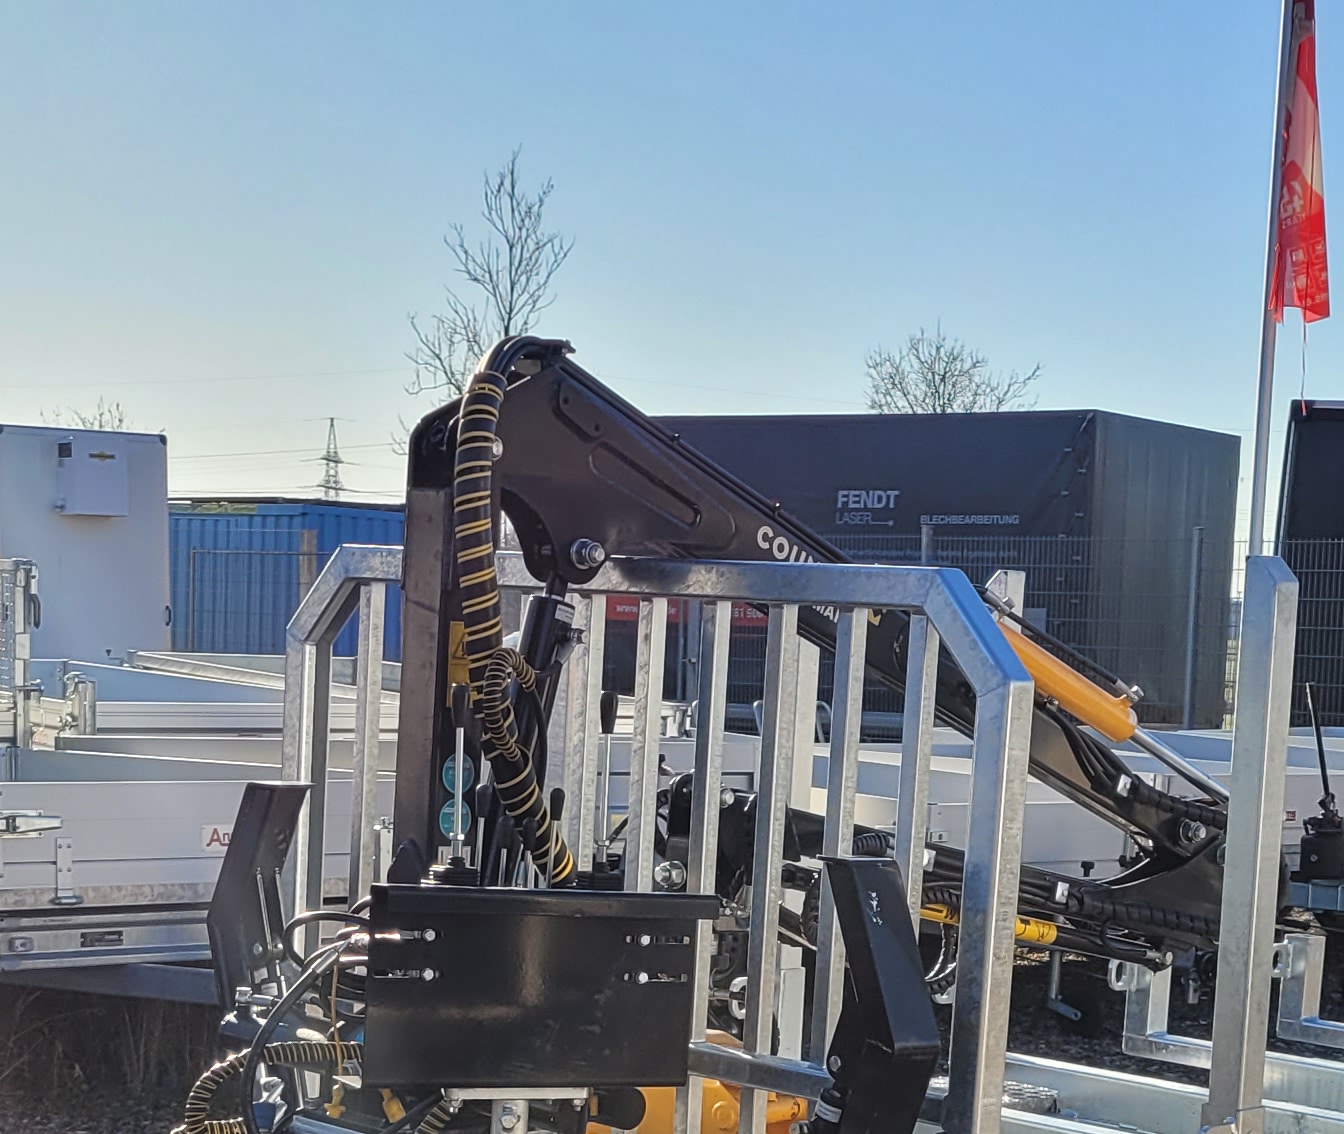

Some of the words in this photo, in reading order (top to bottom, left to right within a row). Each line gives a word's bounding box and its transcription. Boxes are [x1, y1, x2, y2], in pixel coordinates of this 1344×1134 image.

[836, 490, 900, 508] FENDT
[836, 512, 872, 524] LASER
[920, 515, 1019, 524] BLECHBEARBEITUNG
